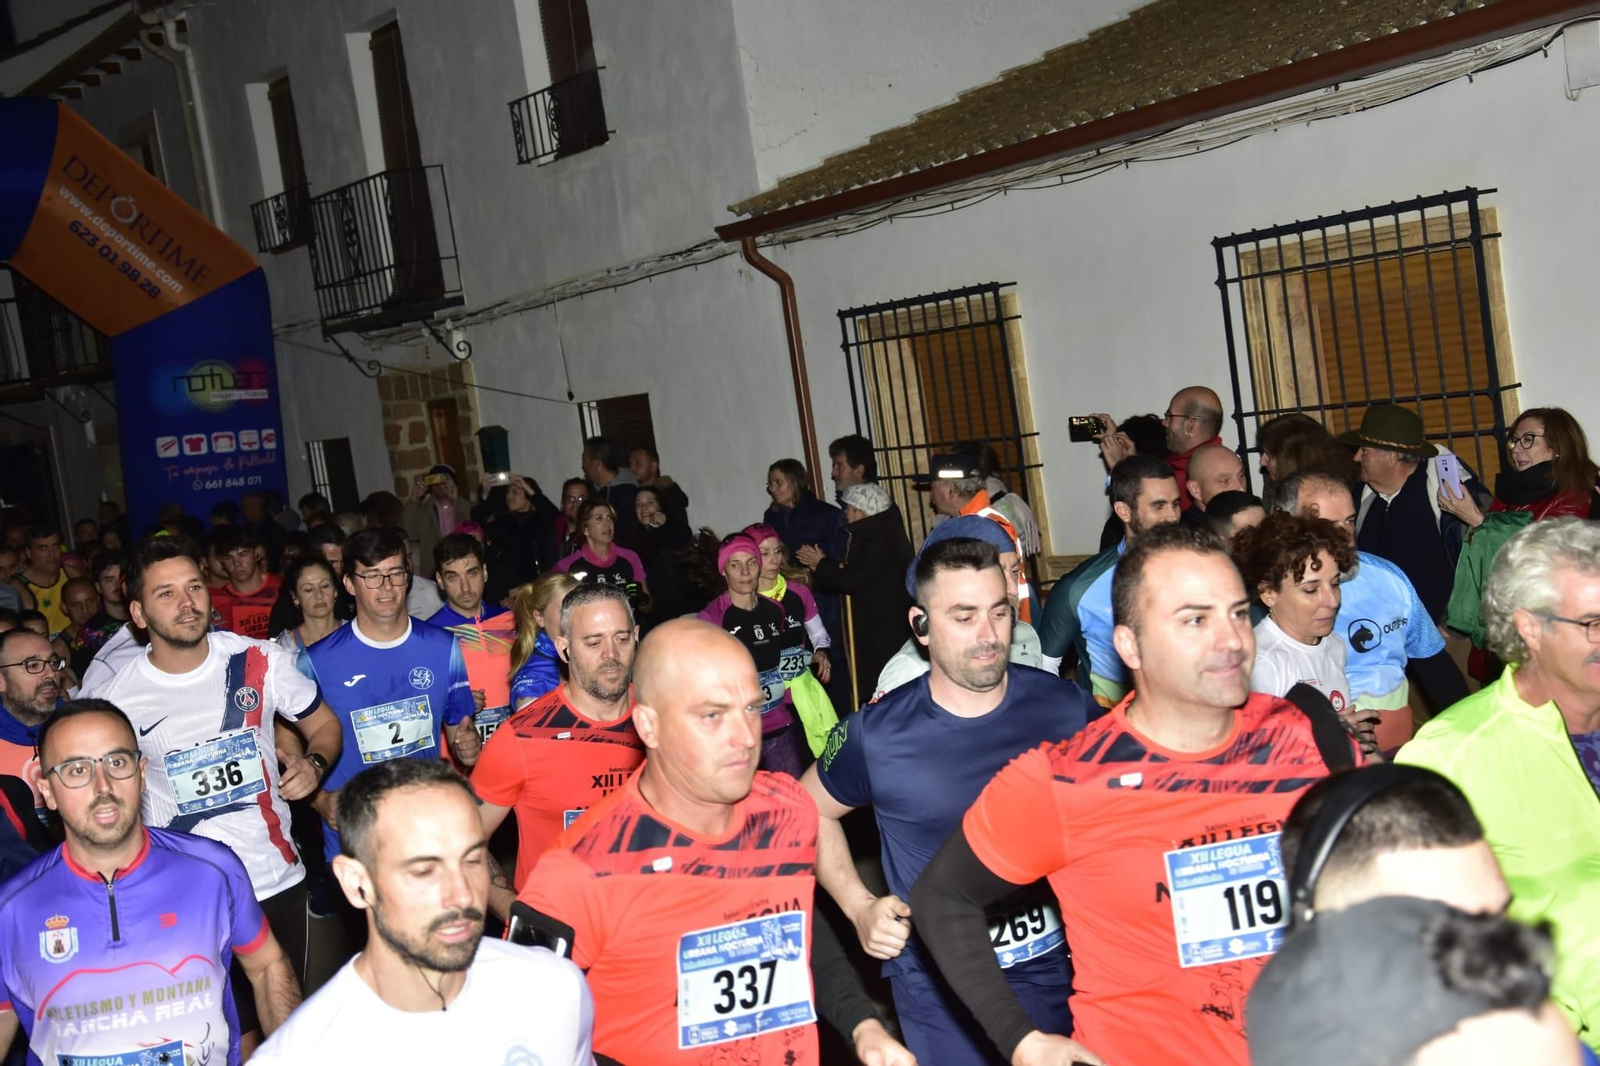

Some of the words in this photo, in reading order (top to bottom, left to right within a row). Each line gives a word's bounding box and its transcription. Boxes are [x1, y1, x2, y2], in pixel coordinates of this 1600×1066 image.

[62, 155, 212, 287] DEPORTIME
[59, 186, 184, 293] www.deportime.com
[69, 220, 100, 248] 623
[98, 245, 119, 266] 01
[118, 261, 142, 282] 98
[139, 277, 162, 299] 28
[205, 479, 222, 489] 661
[225, 476, 245, 487] 848
[781, 655, 805, 671] 233
[388, 722, 404, 745] 2
[192, 760, 243, 797] 336
[591, 774, 614, 789] XII
[1175, 862, 1217, 877] URBANA
[1218, 852, 1271, 869] NOCTURNA
[1190, 851, 1209, 864] XII
[1210, 843, 1252, 861] LEGUA
[1223, 879, 1283, 931] 119
[697, 934, 711, 947] XII
[992, 905, 1046, 948] 269
[683, 945, 717, 960] URBANA
[718, 935, 764, 953] NOCTURNA
[128, 993, 137, 1008] Y
[142, 975, 212, 1006] MONTAÑA
[713, 959, 778, 1014] 337
[155, 992, 215, 1023] REAL
[72, 1057, 86, 1066] XII
[87, 1056, 124, 1066] LEGUA
